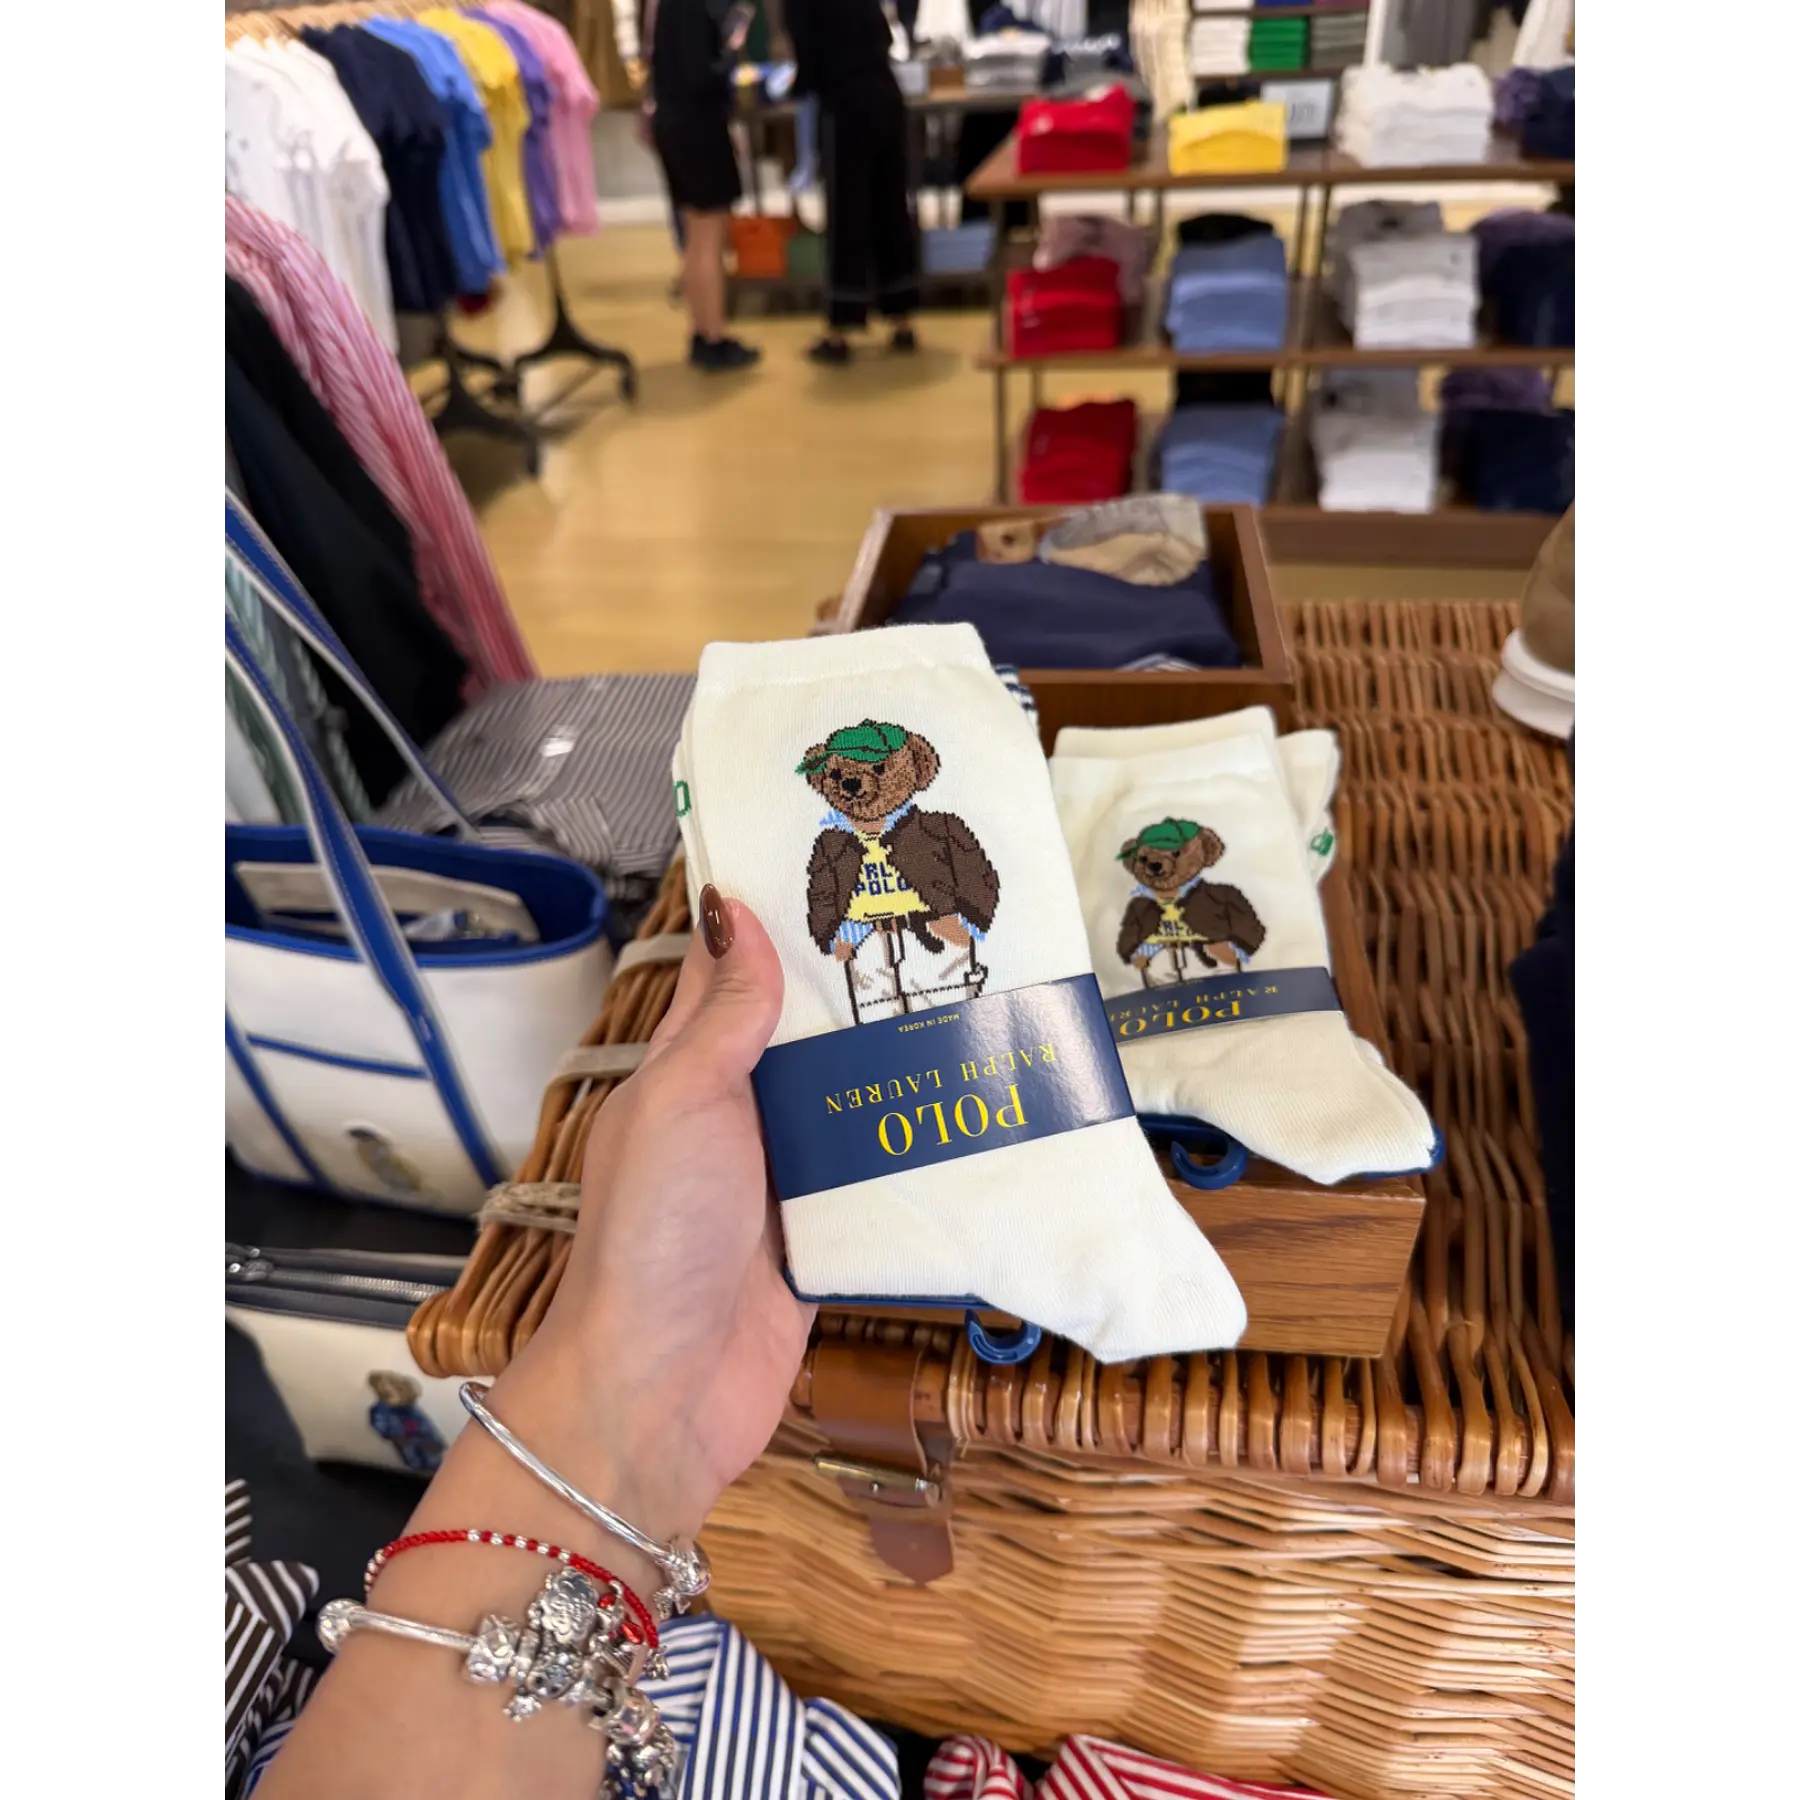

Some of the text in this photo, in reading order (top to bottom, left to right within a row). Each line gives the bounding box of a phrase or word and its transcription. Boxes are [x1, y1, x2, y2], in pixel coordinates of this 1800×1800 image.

[863, 861, 893, 880] RL
[853, 876, 913, 896] POLO
[1196, 985, 1278, 1004] RALPH
[897, 1012, 960, 1033] MADE IN KOREA
[1119, 1000, 1241, 1036] POLO
[825, 1042, 1057, 1115] RALPH LAUREN
[877, 1083, 1028, 1156] POLO
